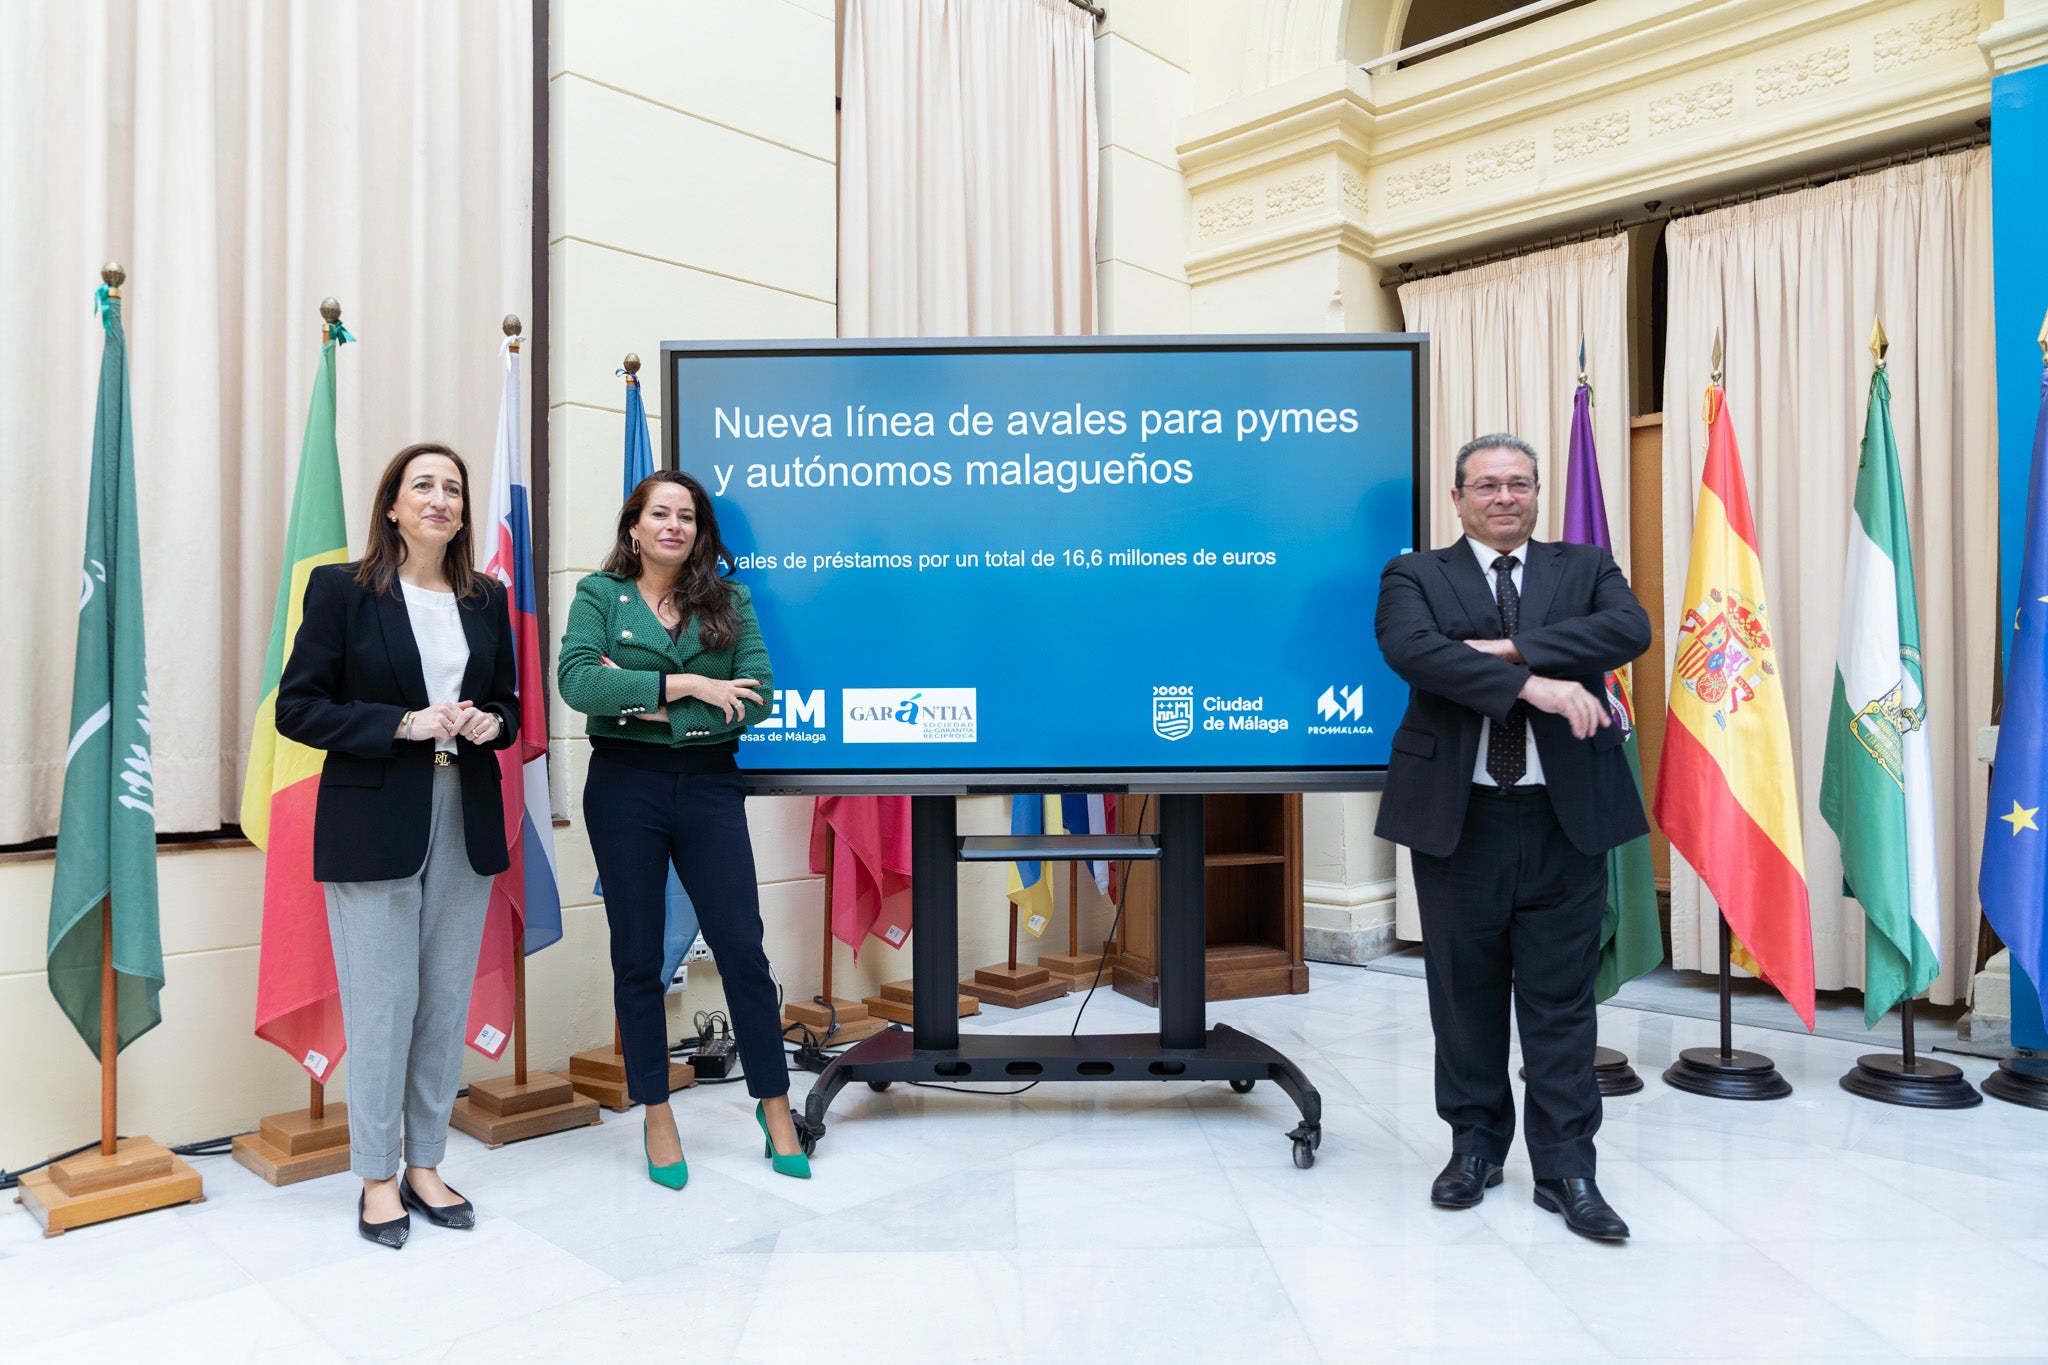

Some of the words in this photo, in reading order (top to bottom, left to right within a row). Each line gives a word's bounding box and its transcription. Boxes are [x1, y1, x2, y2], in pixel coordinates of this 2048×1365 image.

[715, 407, 832, 439] Nueva
[847, 404, 935, 437] línea
[949, 404, 994, 437] de
[1008, 403, 1127, 436] avales
[1142, 409, 1223, 443] para
[1238, 409, 1359, 442] pymes
[714, 465, 735, 497] y
[747, 455, 953, 489] autónomos
[966, 453, 1193, 494] malagueños
[783, 551, 807, 569] de
[814, 551, 913, 573] préstamos
[919, 554, 950, 572] por
[955, 554, 979, 567] un
[985, 550, 1025, 567] total
[1031, 549, 1055, 567] de
[1062, 549, 1103, 569] 16,6
[1109, 549, 1187, 566] millones
[1193, 548, 1217, 566] de
[1222, 551, 1276, 565] euros
[1203, 696, 1263, 712] Ciudad
[1203, 716, 1225, 731] de
[1228, 716, 1289, 734] Málaga
[767, 731, 783, 742] de
[785, 731, 826, 744] Málaga
